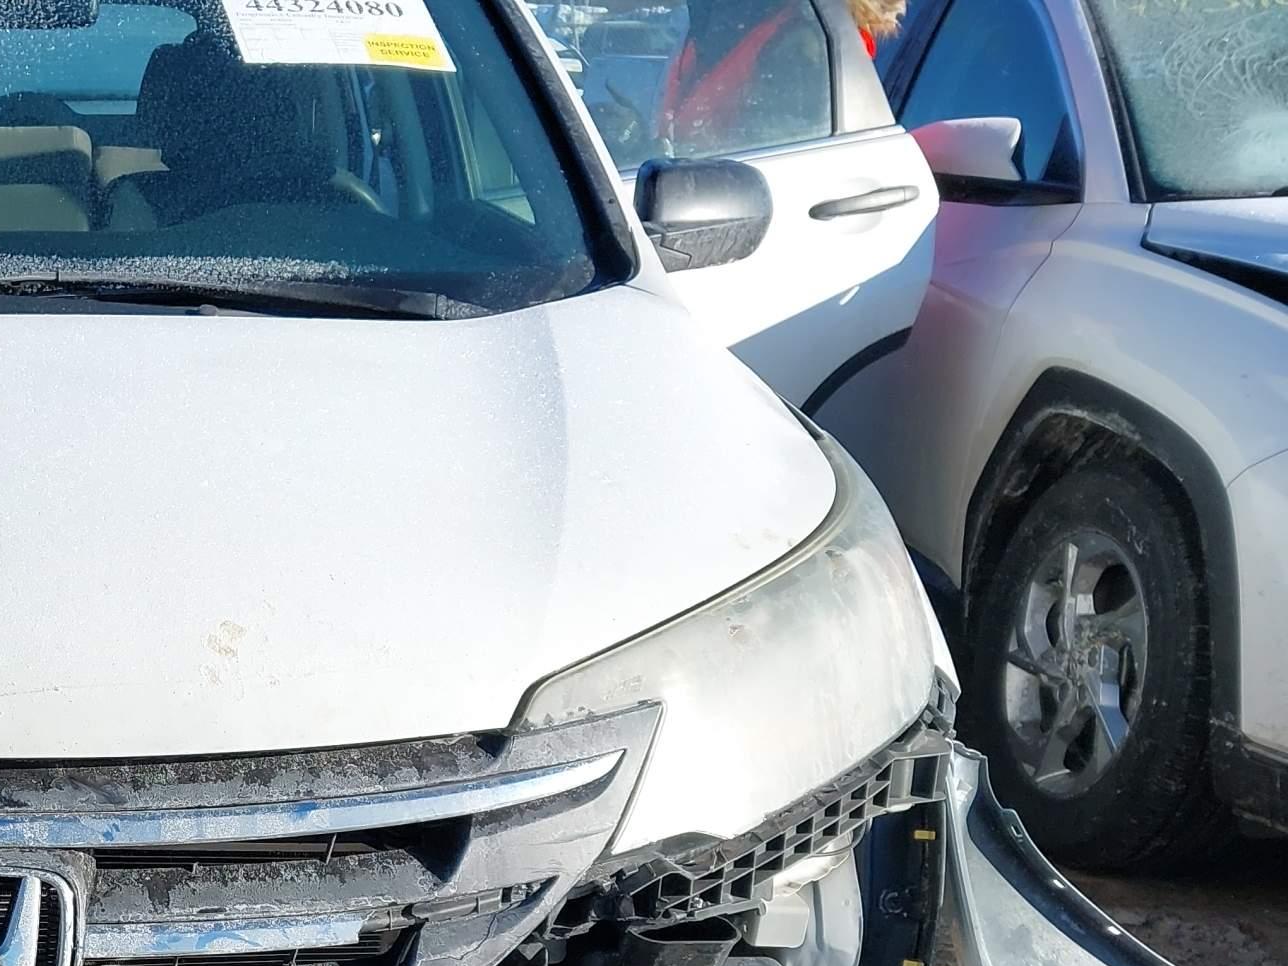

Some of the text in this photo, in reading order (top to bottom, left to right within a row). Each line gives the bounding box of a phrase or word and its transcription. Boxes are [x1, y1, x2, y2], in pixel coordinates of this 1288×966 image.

[244, 0, 404, 18] 44324080
[367, 40, 436, 51] INSPECTION
[379, 48, 430, 58] SERVICE
